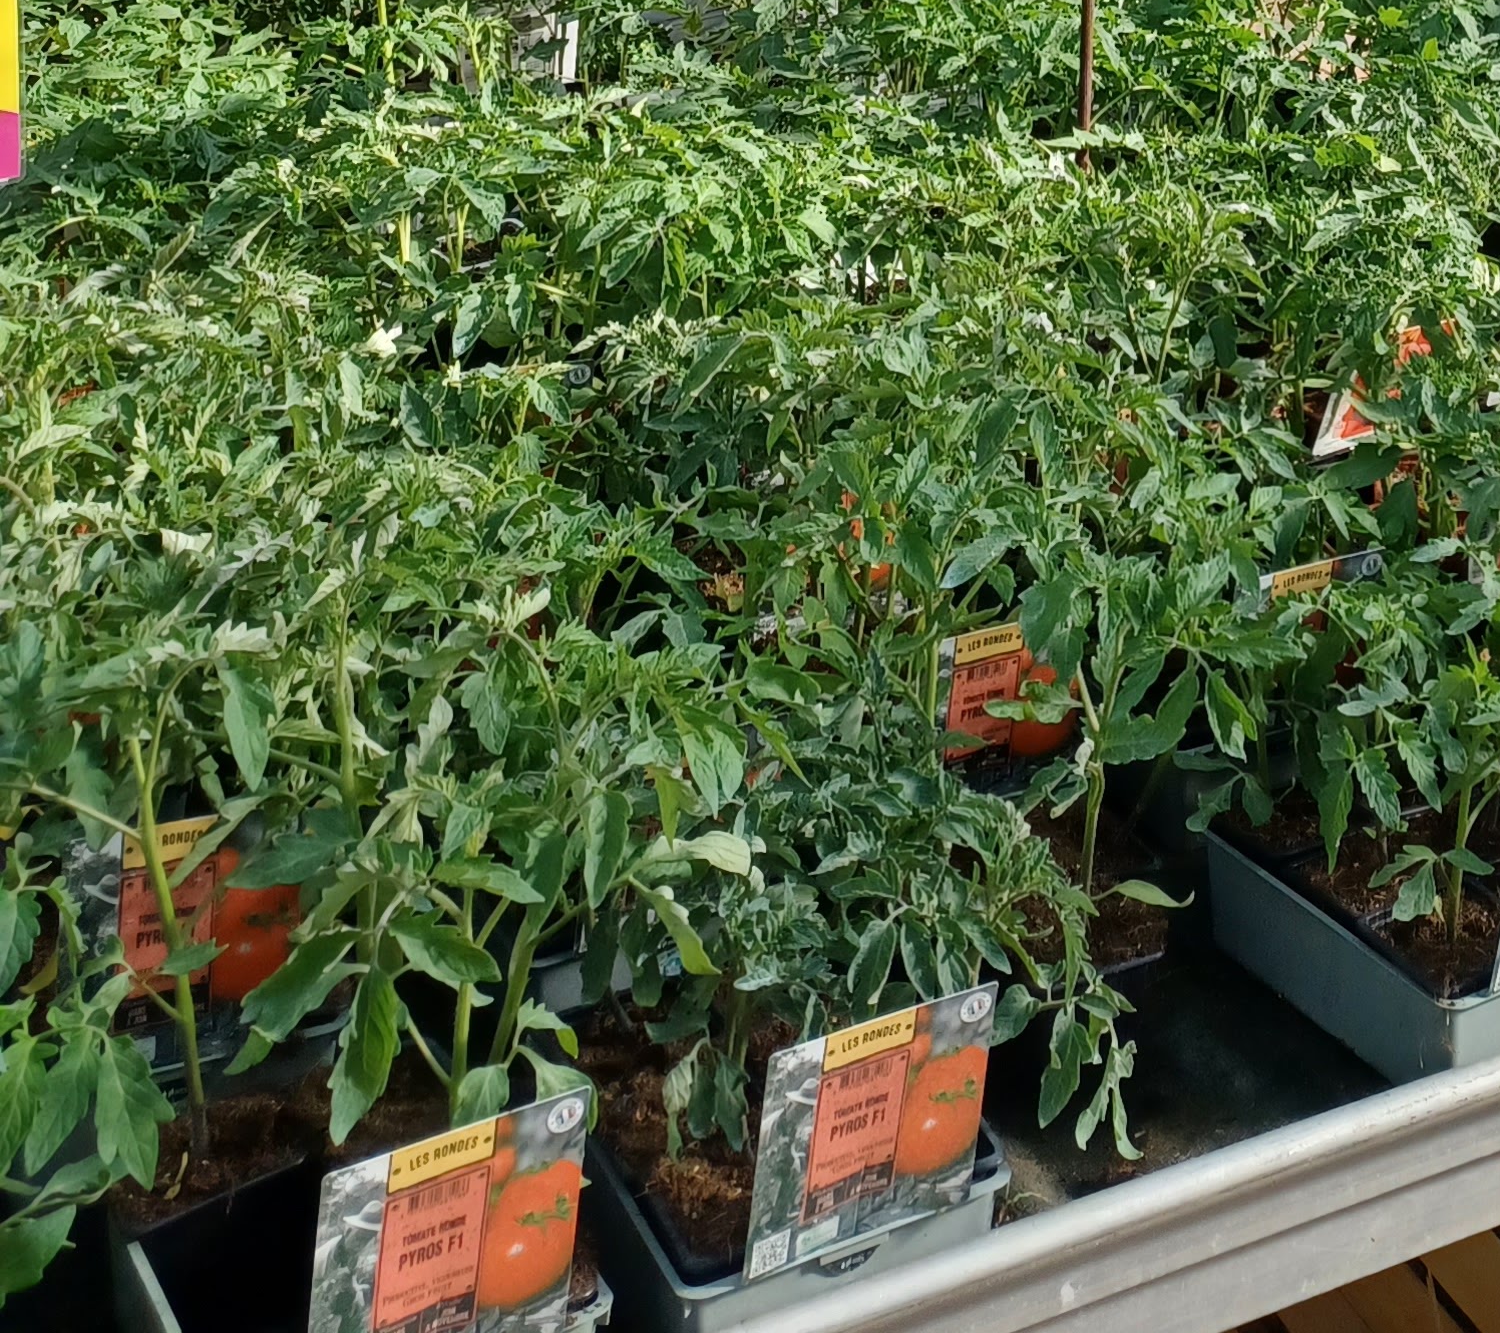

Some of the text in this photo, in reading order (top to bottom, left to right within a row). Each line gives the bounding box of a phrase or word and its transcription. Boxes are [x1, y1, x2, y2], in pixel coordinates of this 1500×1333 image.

[1283, 570, 1322, 589] LES RONDES
[968, 632, 1014, 652] LES RONDES
[841, 1023, 902, 1052] LES RONDES
[834, 1101, 862, 1120] TOMATE
[829, 1108, 886, 1142] PYROS F1
[409, 1136, 479, 1172] LES RONDES
[402, 1227, 436, 1247] TOMATE
[398, 1232, 464, 1273] PYROS F1
